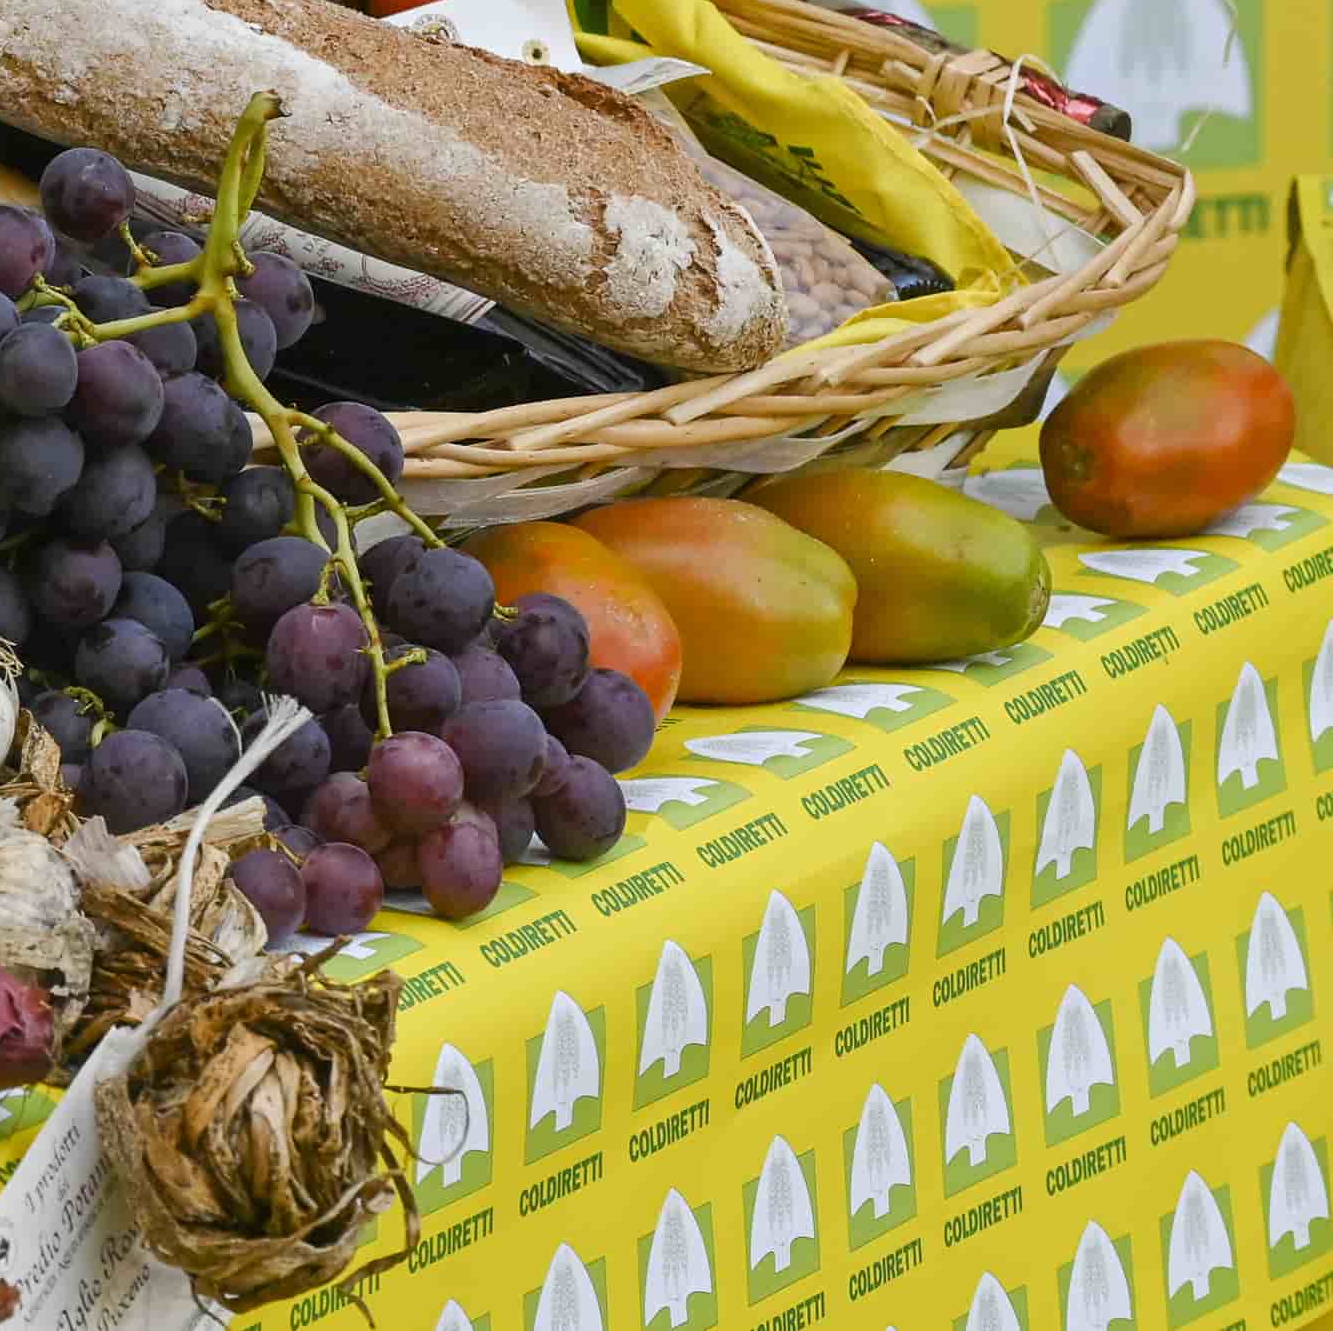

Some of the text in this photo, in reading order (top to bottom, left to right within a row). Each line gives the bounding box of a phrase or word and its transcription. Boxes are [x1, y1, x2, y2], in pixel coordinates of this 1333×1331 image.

[1282, 546, 1333, 593] COLDIRE
[1193, 582, 1270, 635] COLDIRETTI
[1100, 626, 1180, 679] COLDIRETTI
[1004, 670, 1087, 725] COLDIRETTI
[903, 716, 990, 772] COLDIRETTI
[801, 764, 890, 820] COLDIRETTI
[696, 813, 789, 868] COLDIRETTI
[1221, 810, 1296, 866] COLDIRETTI
[591, 861, 686, 917] COLDIRETTI
[1125, 854, 1200, 911] COLDIRETTI
[479, 909, 577, 968] COLDIRETTI
[1028, 901, 1105, 959] COLDIRETTI
[398, 961, 465, 1011] DIRETTI
[933, 947, 1006, 1007] COLDIRETTI
[835, 996, 910, 1057] COLDIRETTI
[734, 1046, 812, 1110] COLDIRETTI
[1247, 1039, 1322, 1098] COLDIRETTI
[629, 1099, 710, 1163] COLDIRETTI
[1150, 1086, 1225, 1146] COLDIRETTI
[519, 1151, 603, 1217] COLDIRETTI
[1045, 1136, 1127, 1197] COLDIRETTI
[408, 1207, 494, 1274] COLDIRETTI
[944, 1186, 1023, 1247] COLDIRETTI
[849, 1237, 923, 1302] COLDIRETTI
